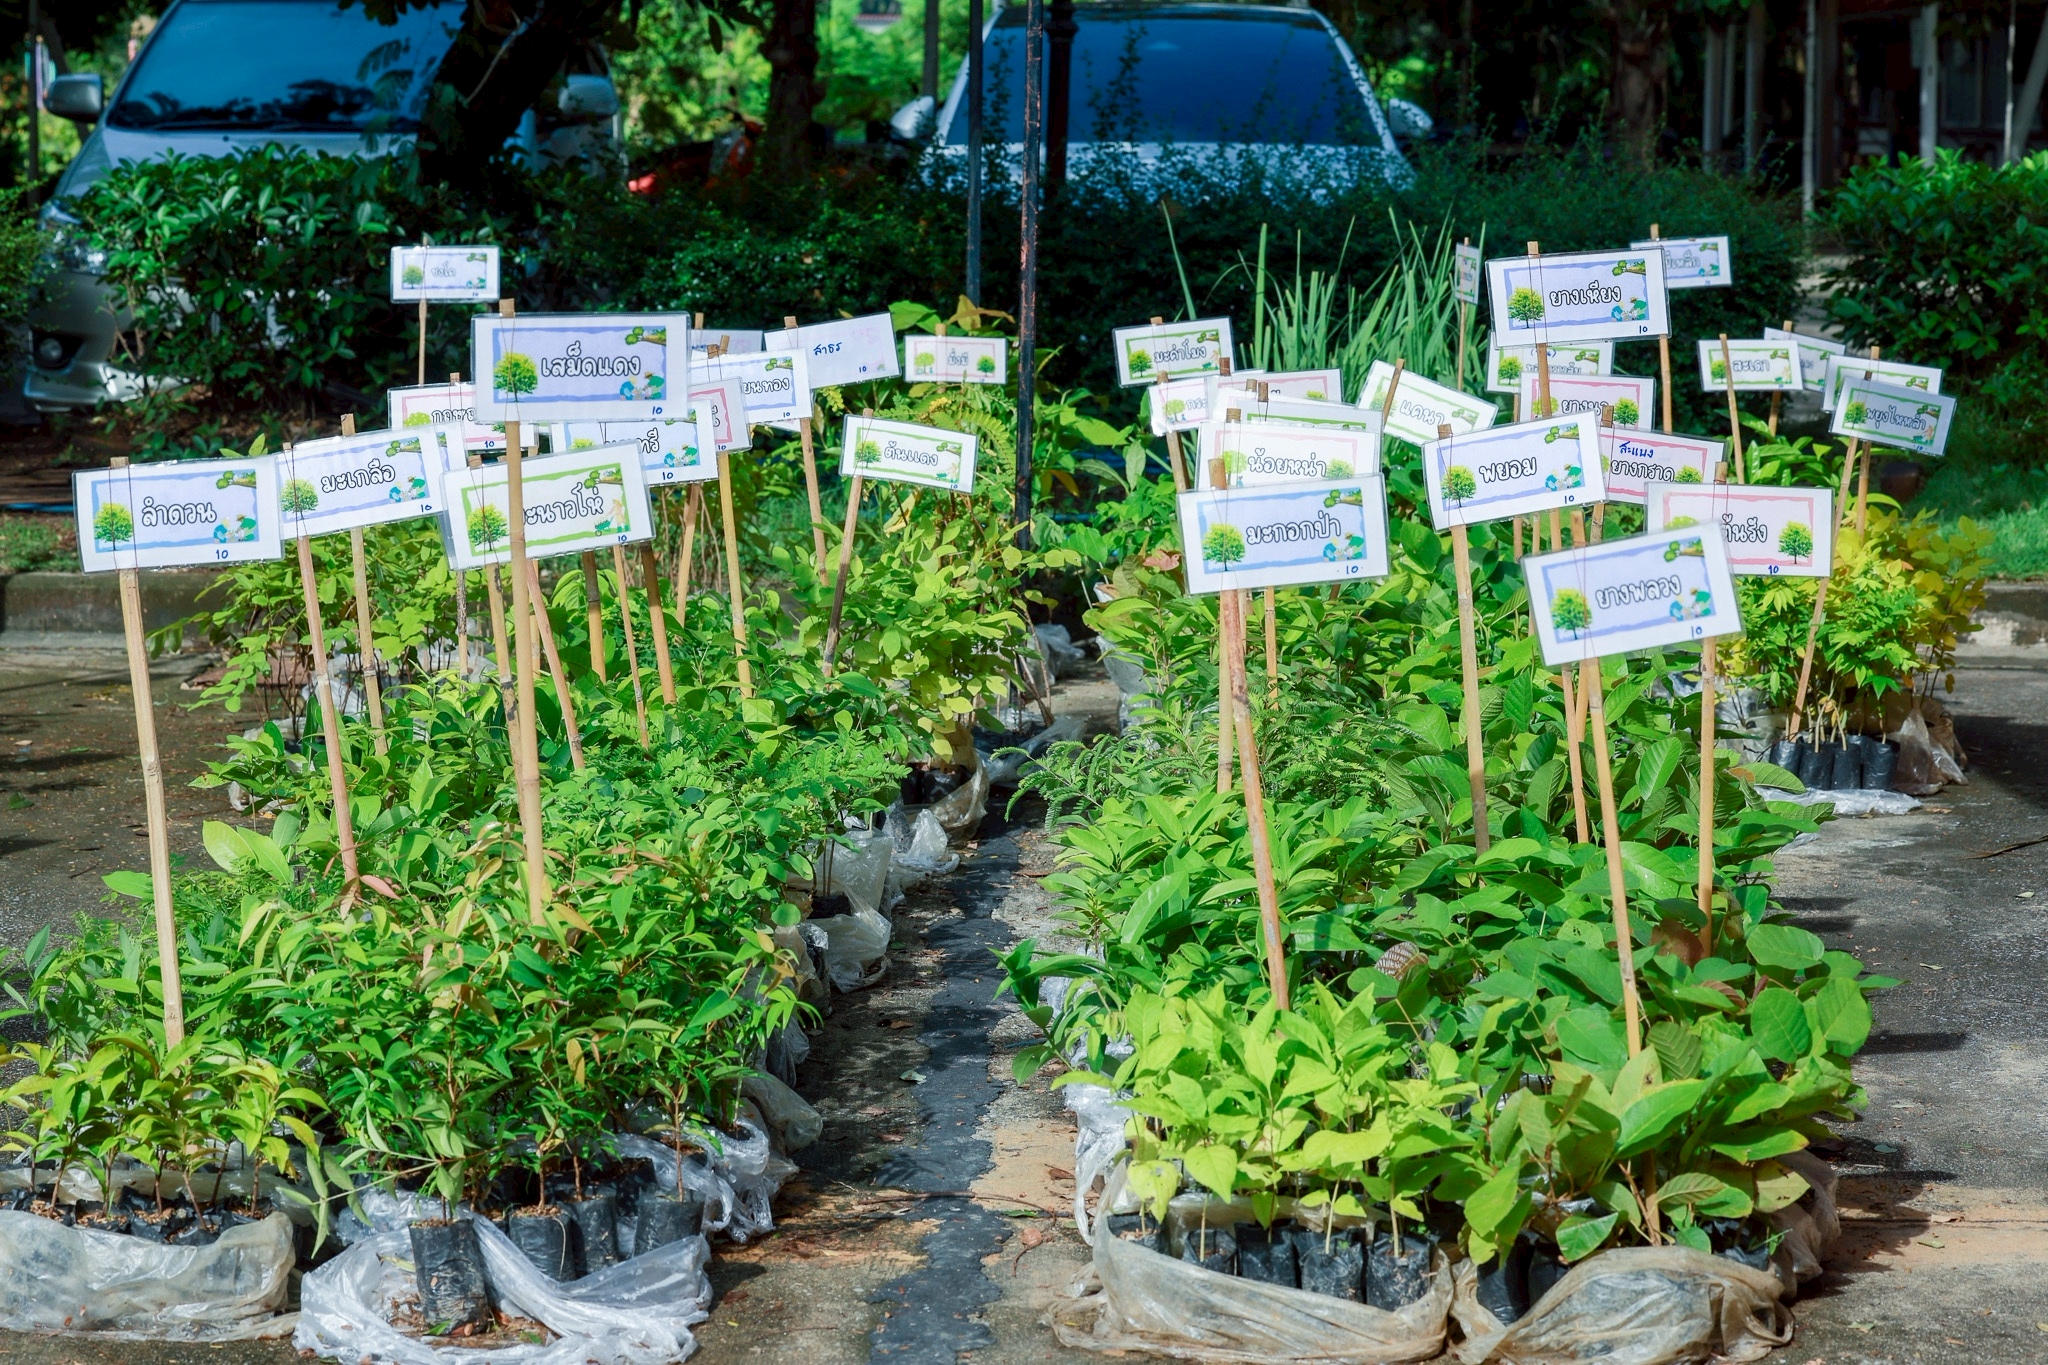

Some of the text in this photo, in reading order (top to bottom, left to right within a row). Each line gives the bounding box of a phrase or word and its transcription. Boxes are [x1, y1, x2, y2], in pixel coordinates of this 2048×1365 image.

[1549, 280, 1622, 308] ยางเหียง
[1639, 325, 1649, 335] 10
[541, 340, 643, 378] เสม็ดแดง
[1153, 338, 1207, 364] มะค่าโมง
[859, 365, 867, 373] 10
[1732, 359, 1770, 373] สะเดา
[652, 406, 663, 415] 10
[1399, 399, 1445, 427] แคนา
[484, 440, 495, 450] 10
[884, 440, 939, 467] ต้นแดง
[1247, 447, 1327, 478] น้อยหน่า
[1479, 457, 1537, 483] พยอม
[1611, 460, 1676, 482] ยางกราด
[321, 458, 396, 493] มะเกลือ
[662, 471, 674, 481] 10
[420, 503, 433, 513] 10
[521, 482, 604, 526] ะนาวโห่
[1564, 495, 1575, 505] 10
[142, 496, 218, 527] ลำดวน
[1245, 510, 1342, 546] มะกอกป่า
[617, 534, 628, 543] 10
[216, 549, 229, 560] 10
[1346, 565, 1359, 575] 10
[1767, 565, 1779, 575] 10
[1595, 574, 1682, 609] ยางพลวง
[1691, 625, 1703, 638] 10
